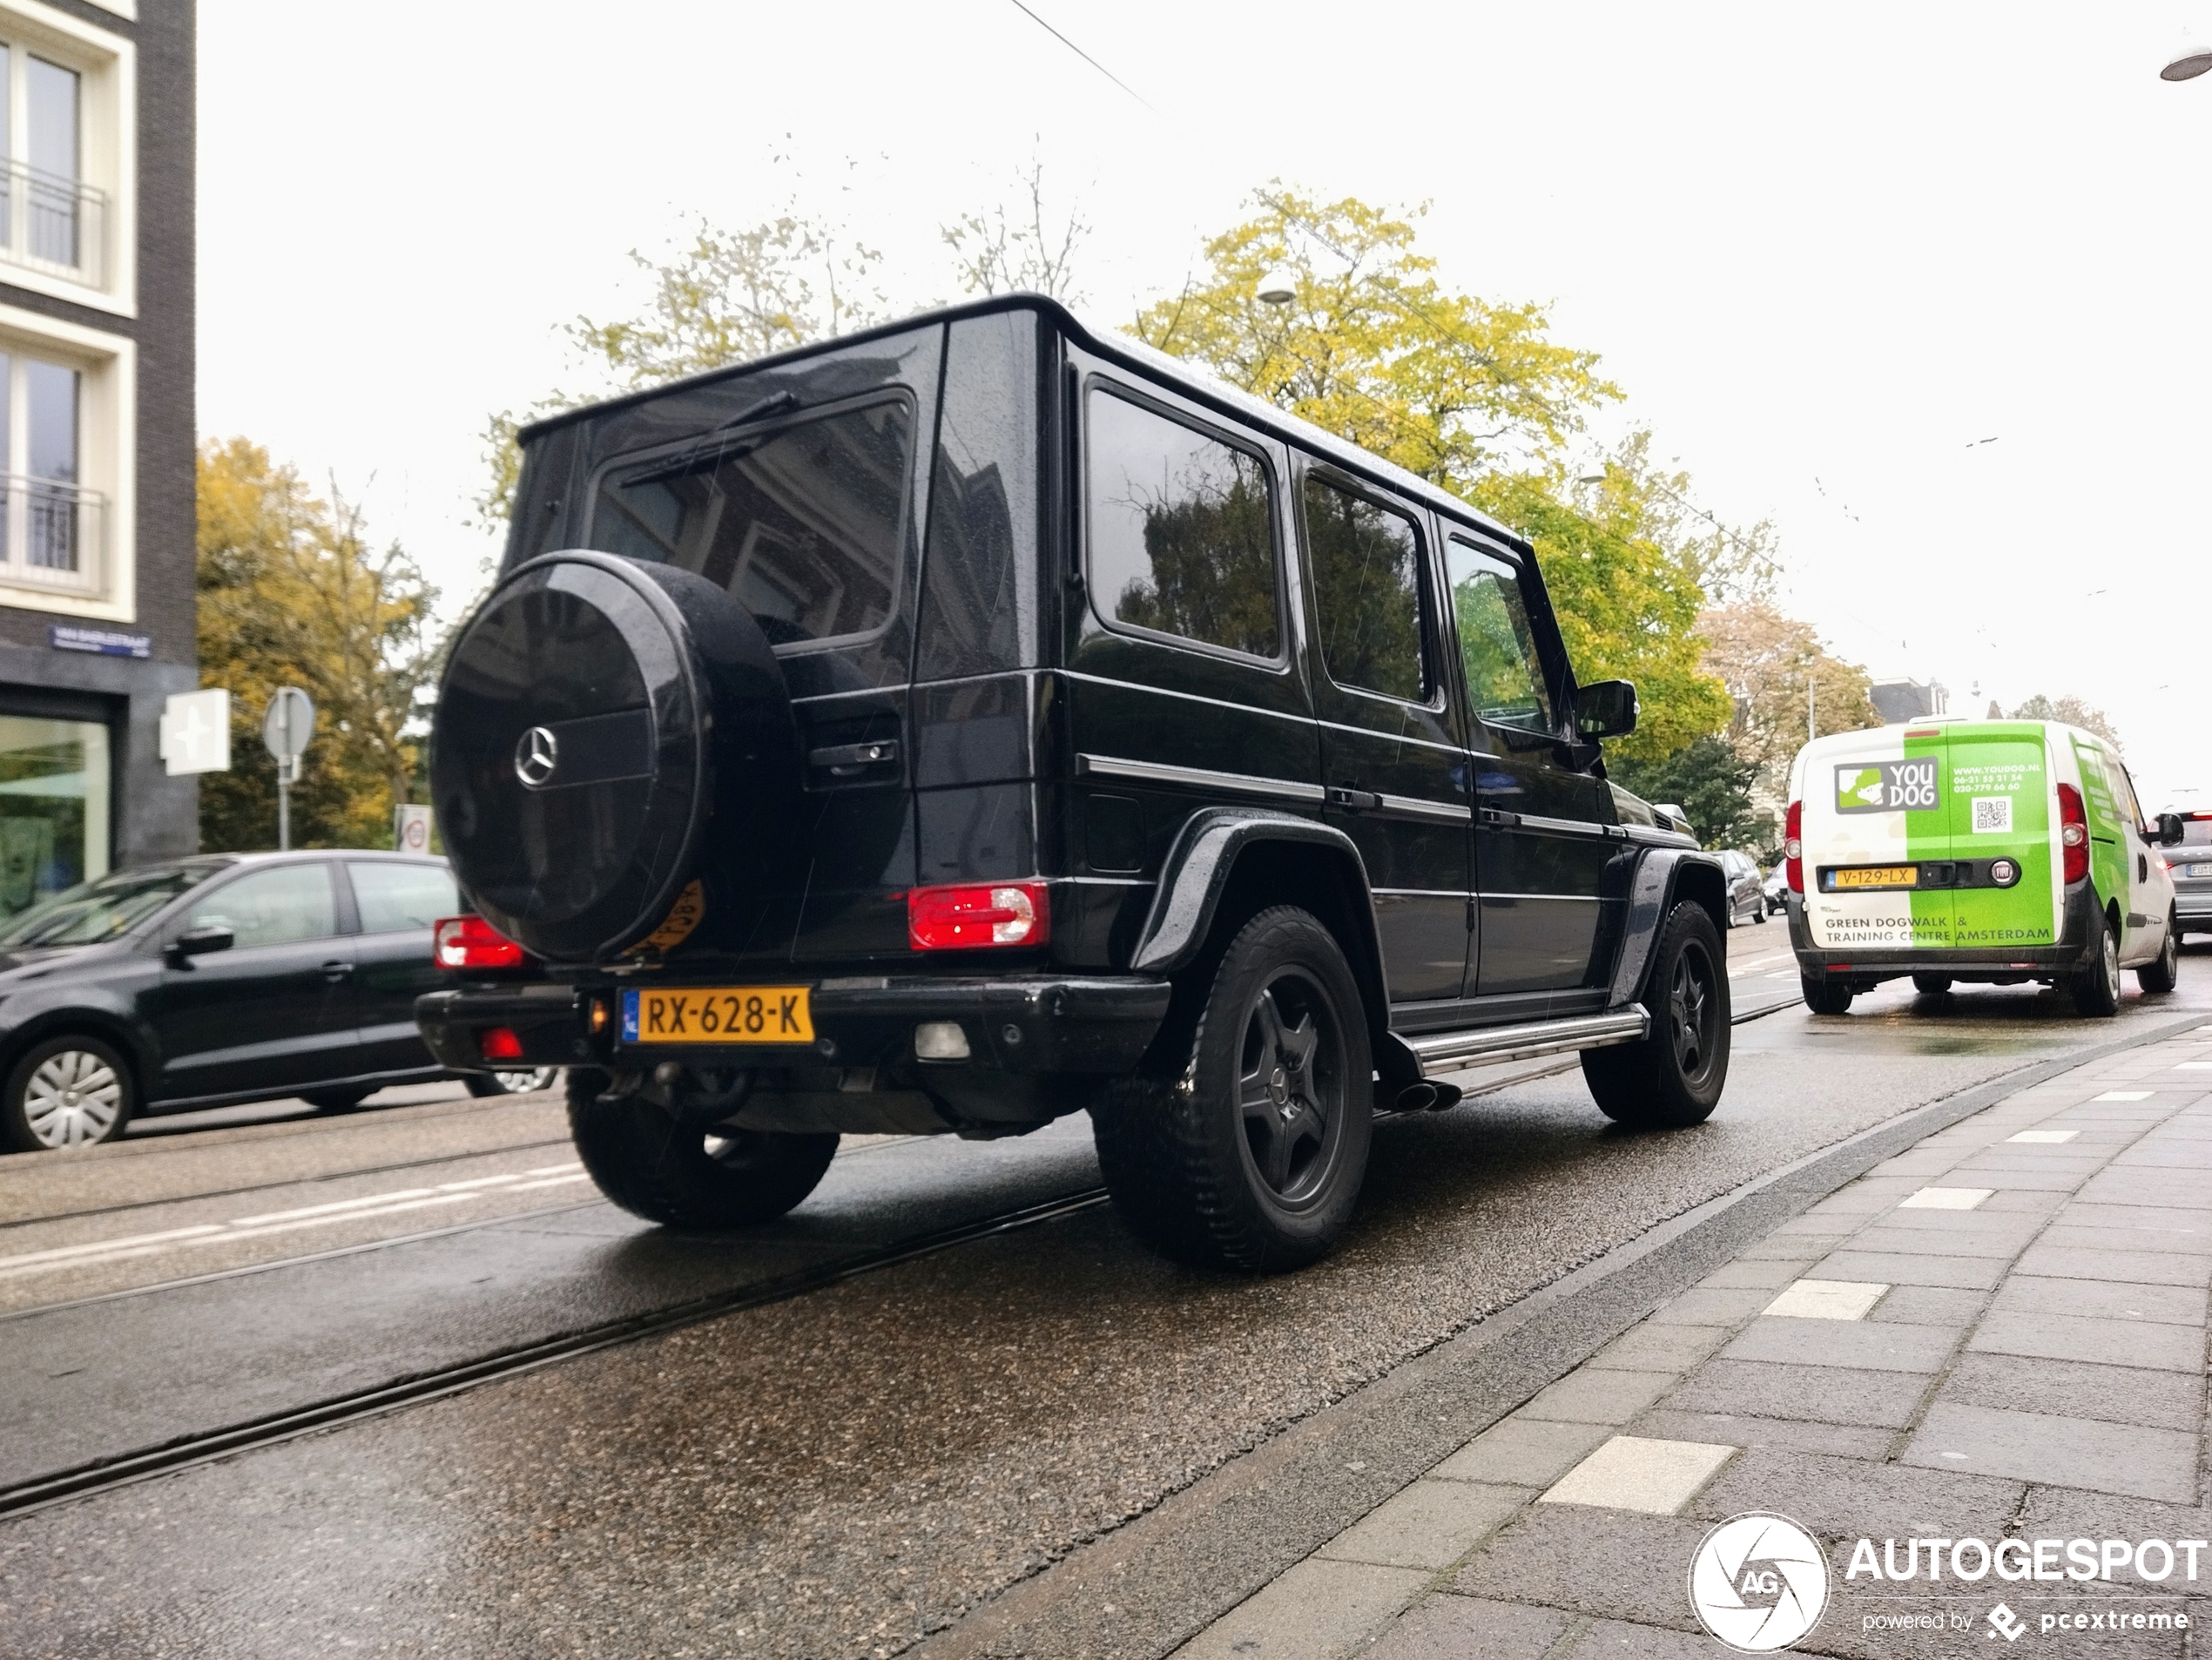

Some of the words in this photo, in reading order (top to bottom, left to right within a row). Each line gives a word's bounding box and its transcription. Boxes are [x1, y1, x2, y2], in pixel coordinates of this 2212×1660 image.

[1889, 764, 1933, 786] YOU
[1953, 776, 1979, 785] 06-21
[1889, 784, 1935, 806] DOG
[1953, 784, 1992, 793] 020-779
[1843, 869, 1908, 884] V-129-LX
[1825, 918, 1870, 928] GREEN
[1876, 917, 1947, 928] DOGWALK
[1957, 916, 1966, 926] &
[1826, 931, 1894, 942] TRAINING
[1899, 931, 1950, 941] CENTRE
[1956, 928, 2050, 941] AMSTERDAM
[647, 995, 801, 1034] RX-628-K
